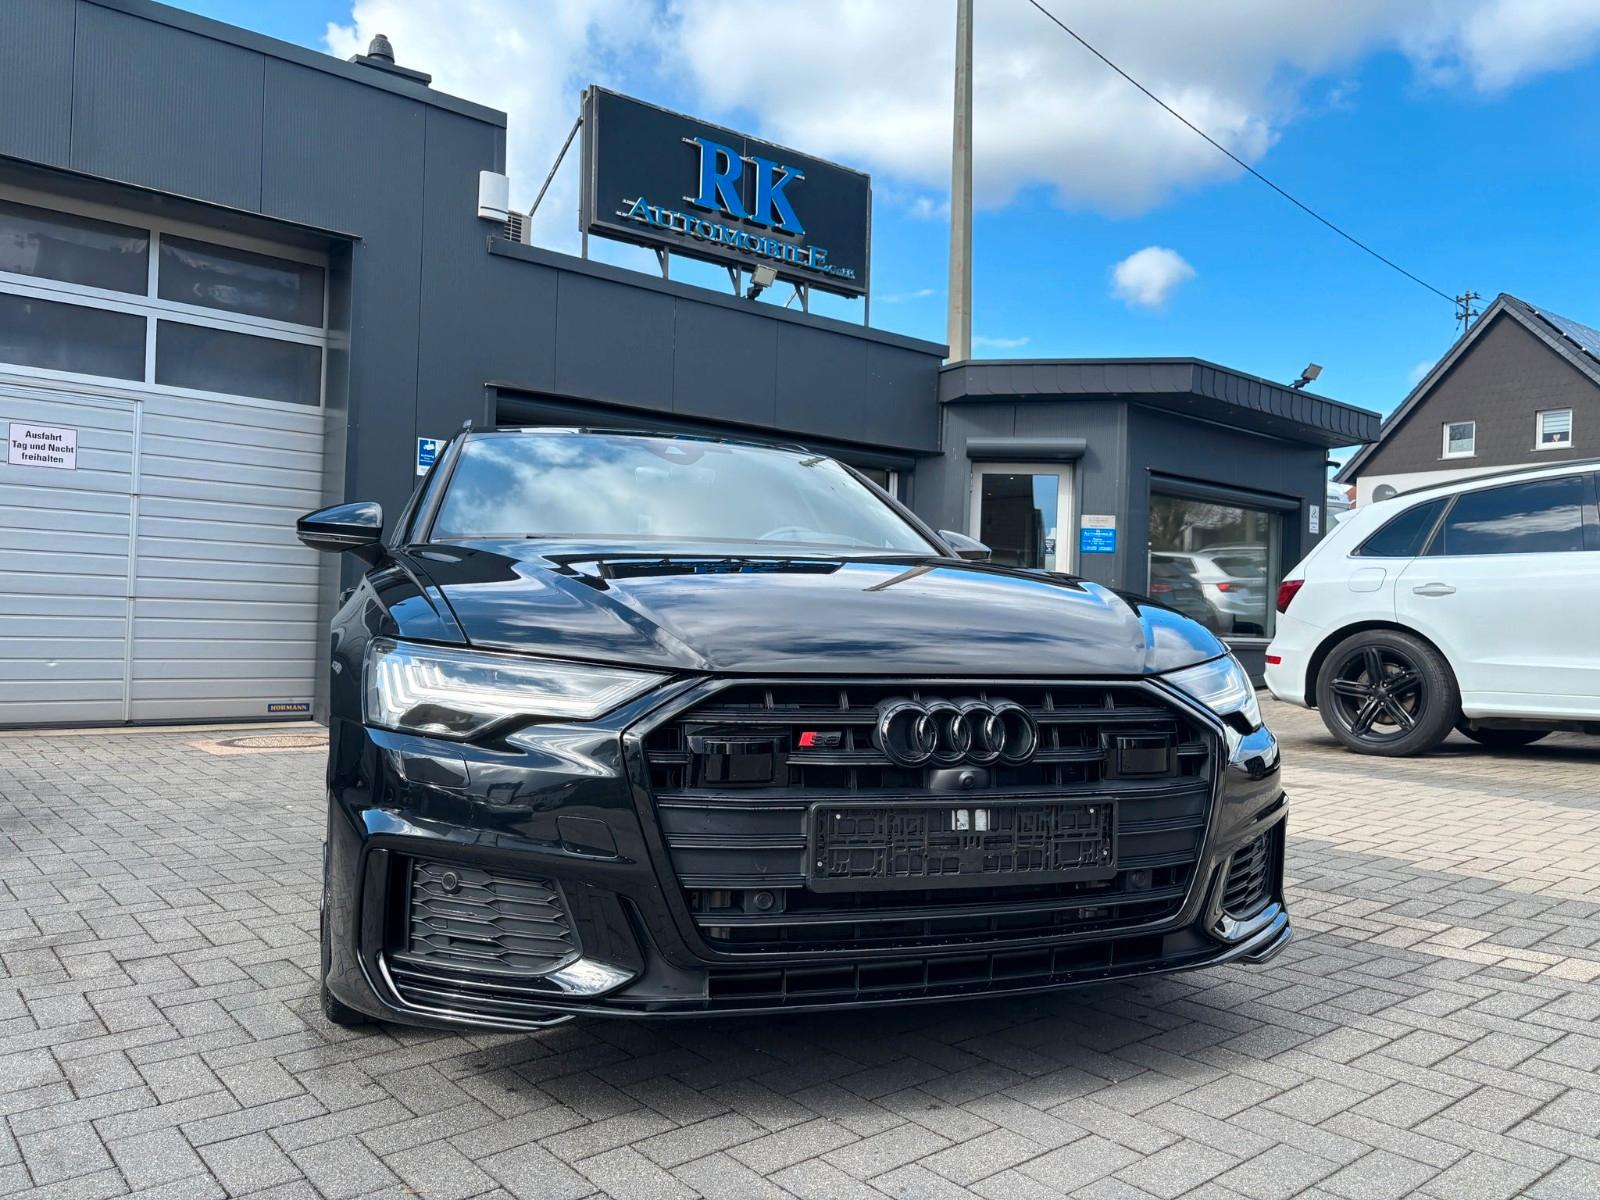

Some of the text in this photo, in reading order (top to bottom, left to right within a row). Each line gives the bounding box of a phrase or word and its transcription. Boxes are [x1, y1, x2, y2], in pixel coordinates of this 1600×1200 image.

[682, 136, 806, 235] RK
[25, 430, 62, 441] Ausfahrt
[12, 440, 74, 453] Tag und Nacht
[21, 452, 64, 463] freihalten
